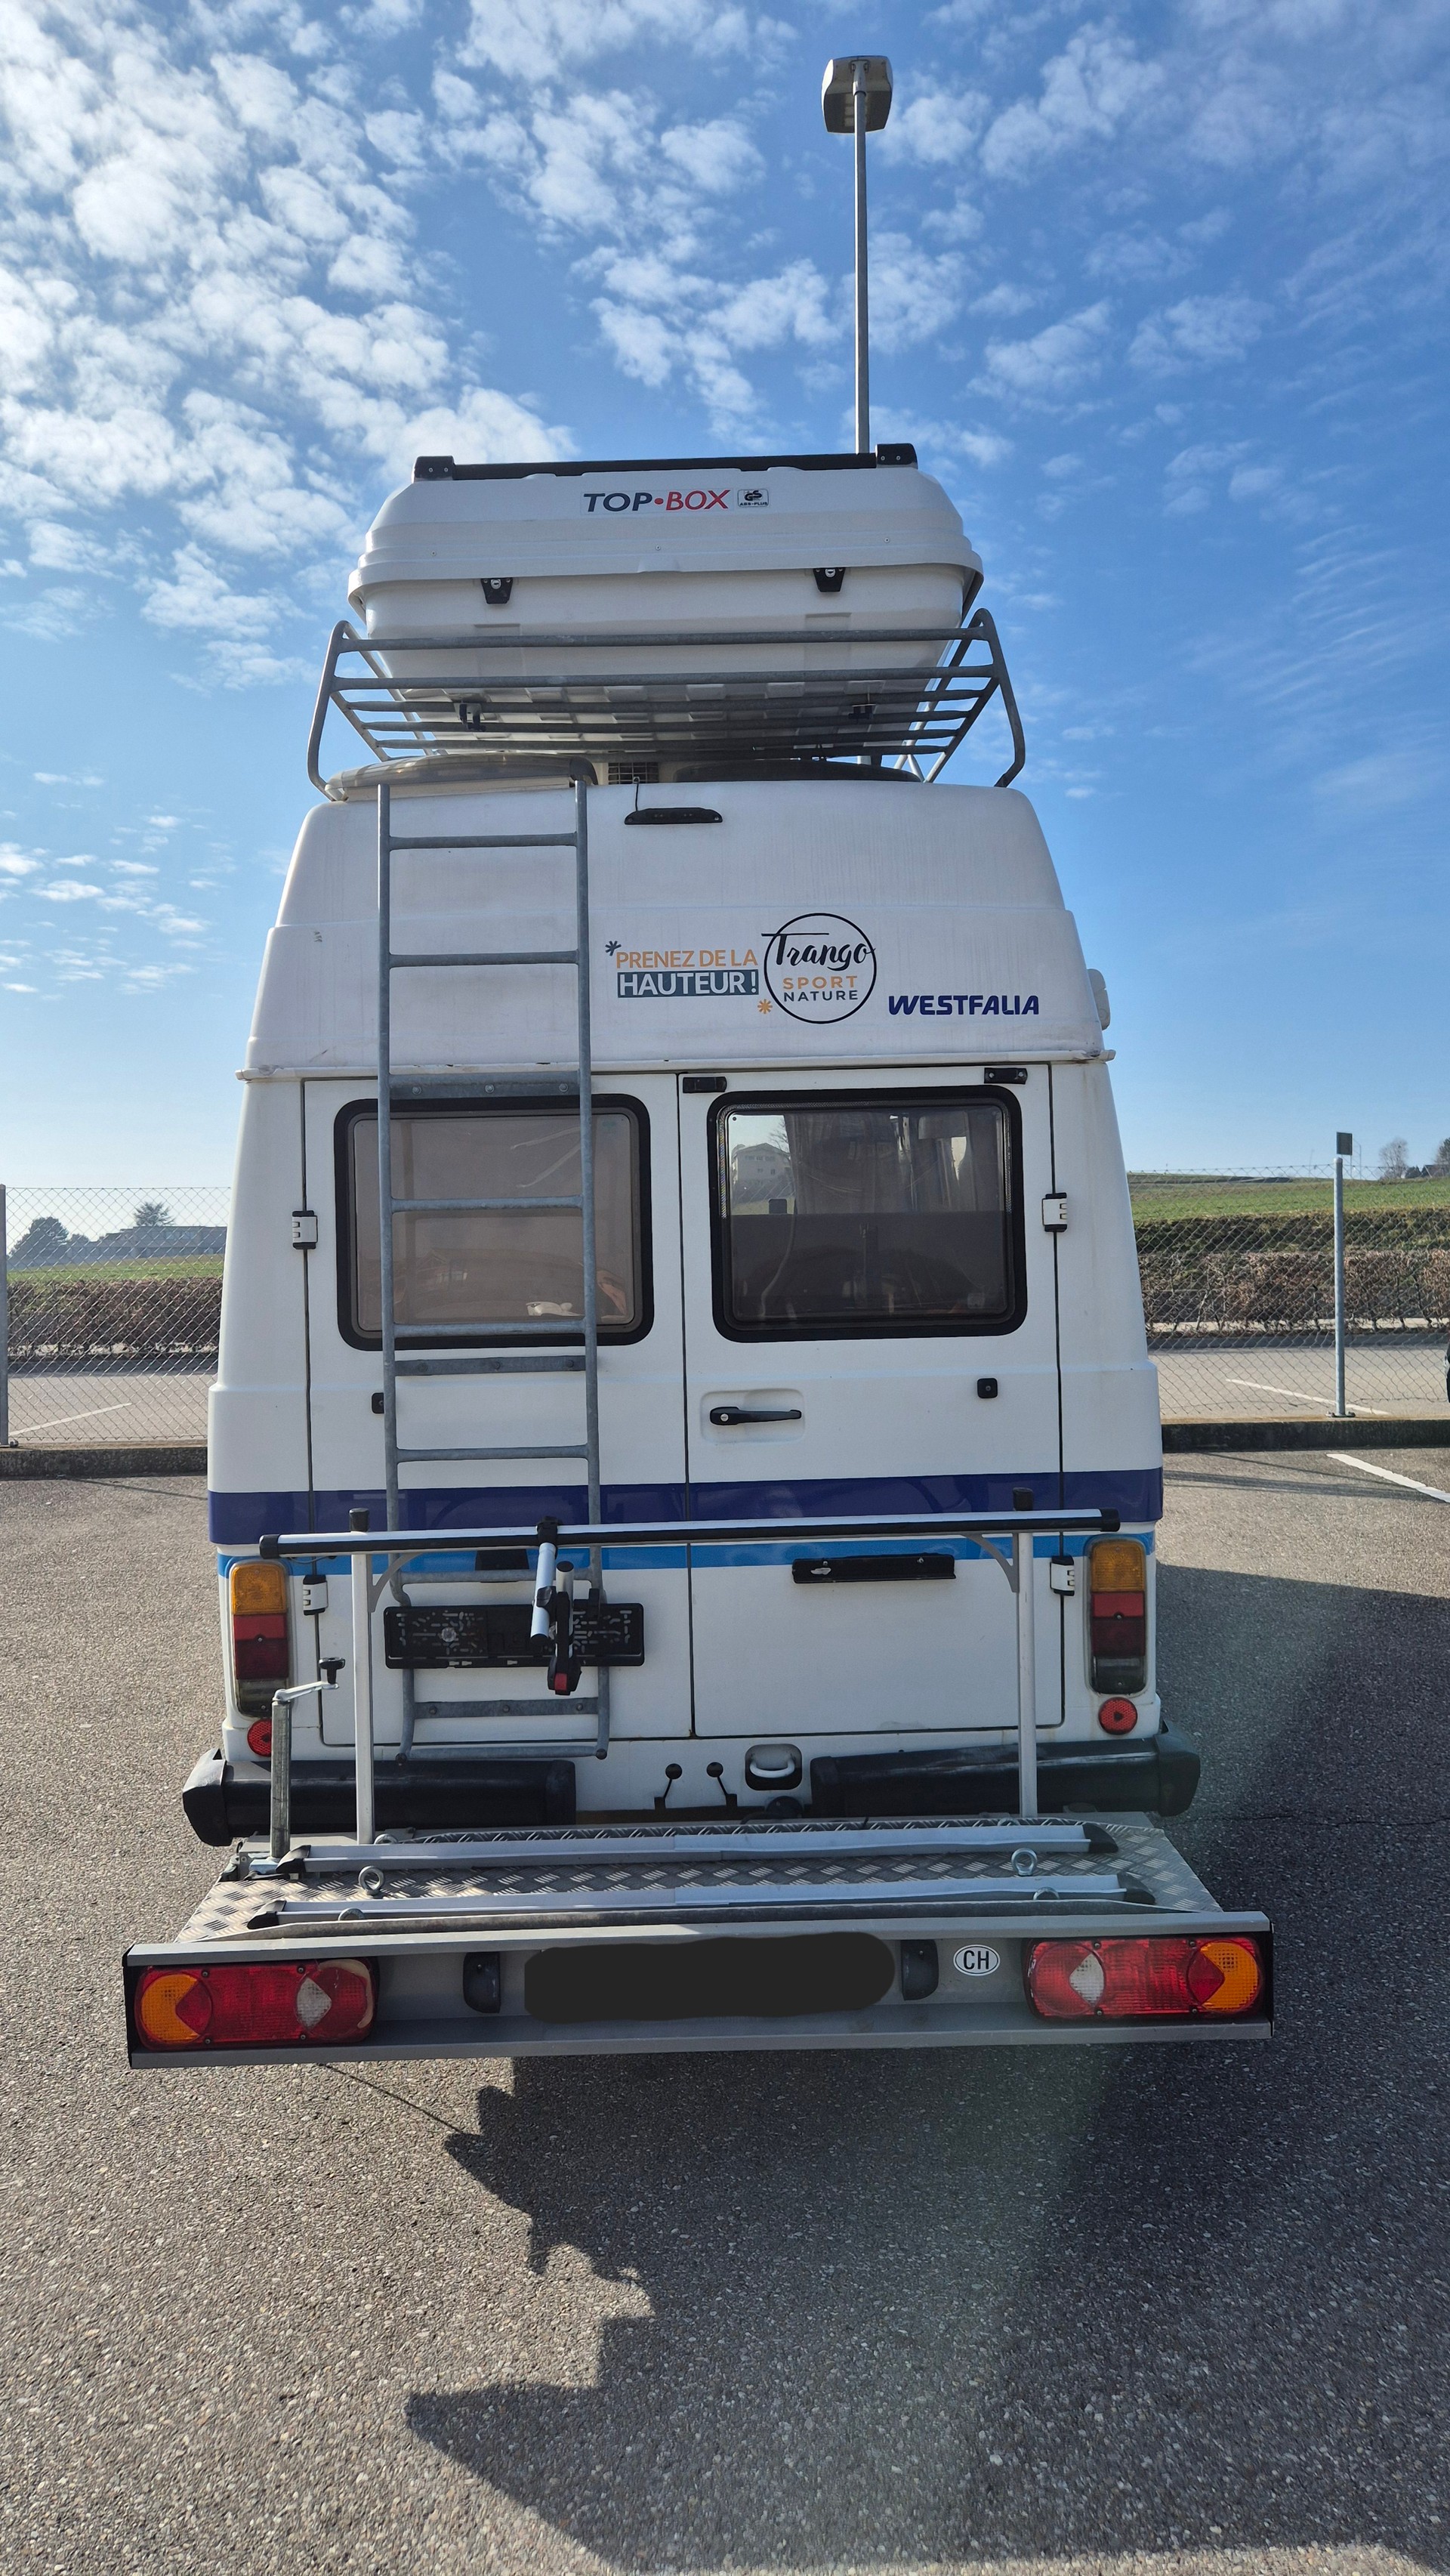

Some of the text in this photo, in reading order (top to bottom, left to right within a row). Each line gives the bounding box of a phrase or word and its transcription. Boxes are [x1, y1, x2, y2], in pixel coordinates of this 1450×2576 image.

[616, 949, 758, 968] PRENEZ DE LA
[761, 933, 876, 971] Trango
[782, 975, 857, 990] SPORT
[784, 990, 858, 1002] NATURE
[888, 995, 1039, 1015] WESTFALIA
[963, 1950, 989, 1970] CH
